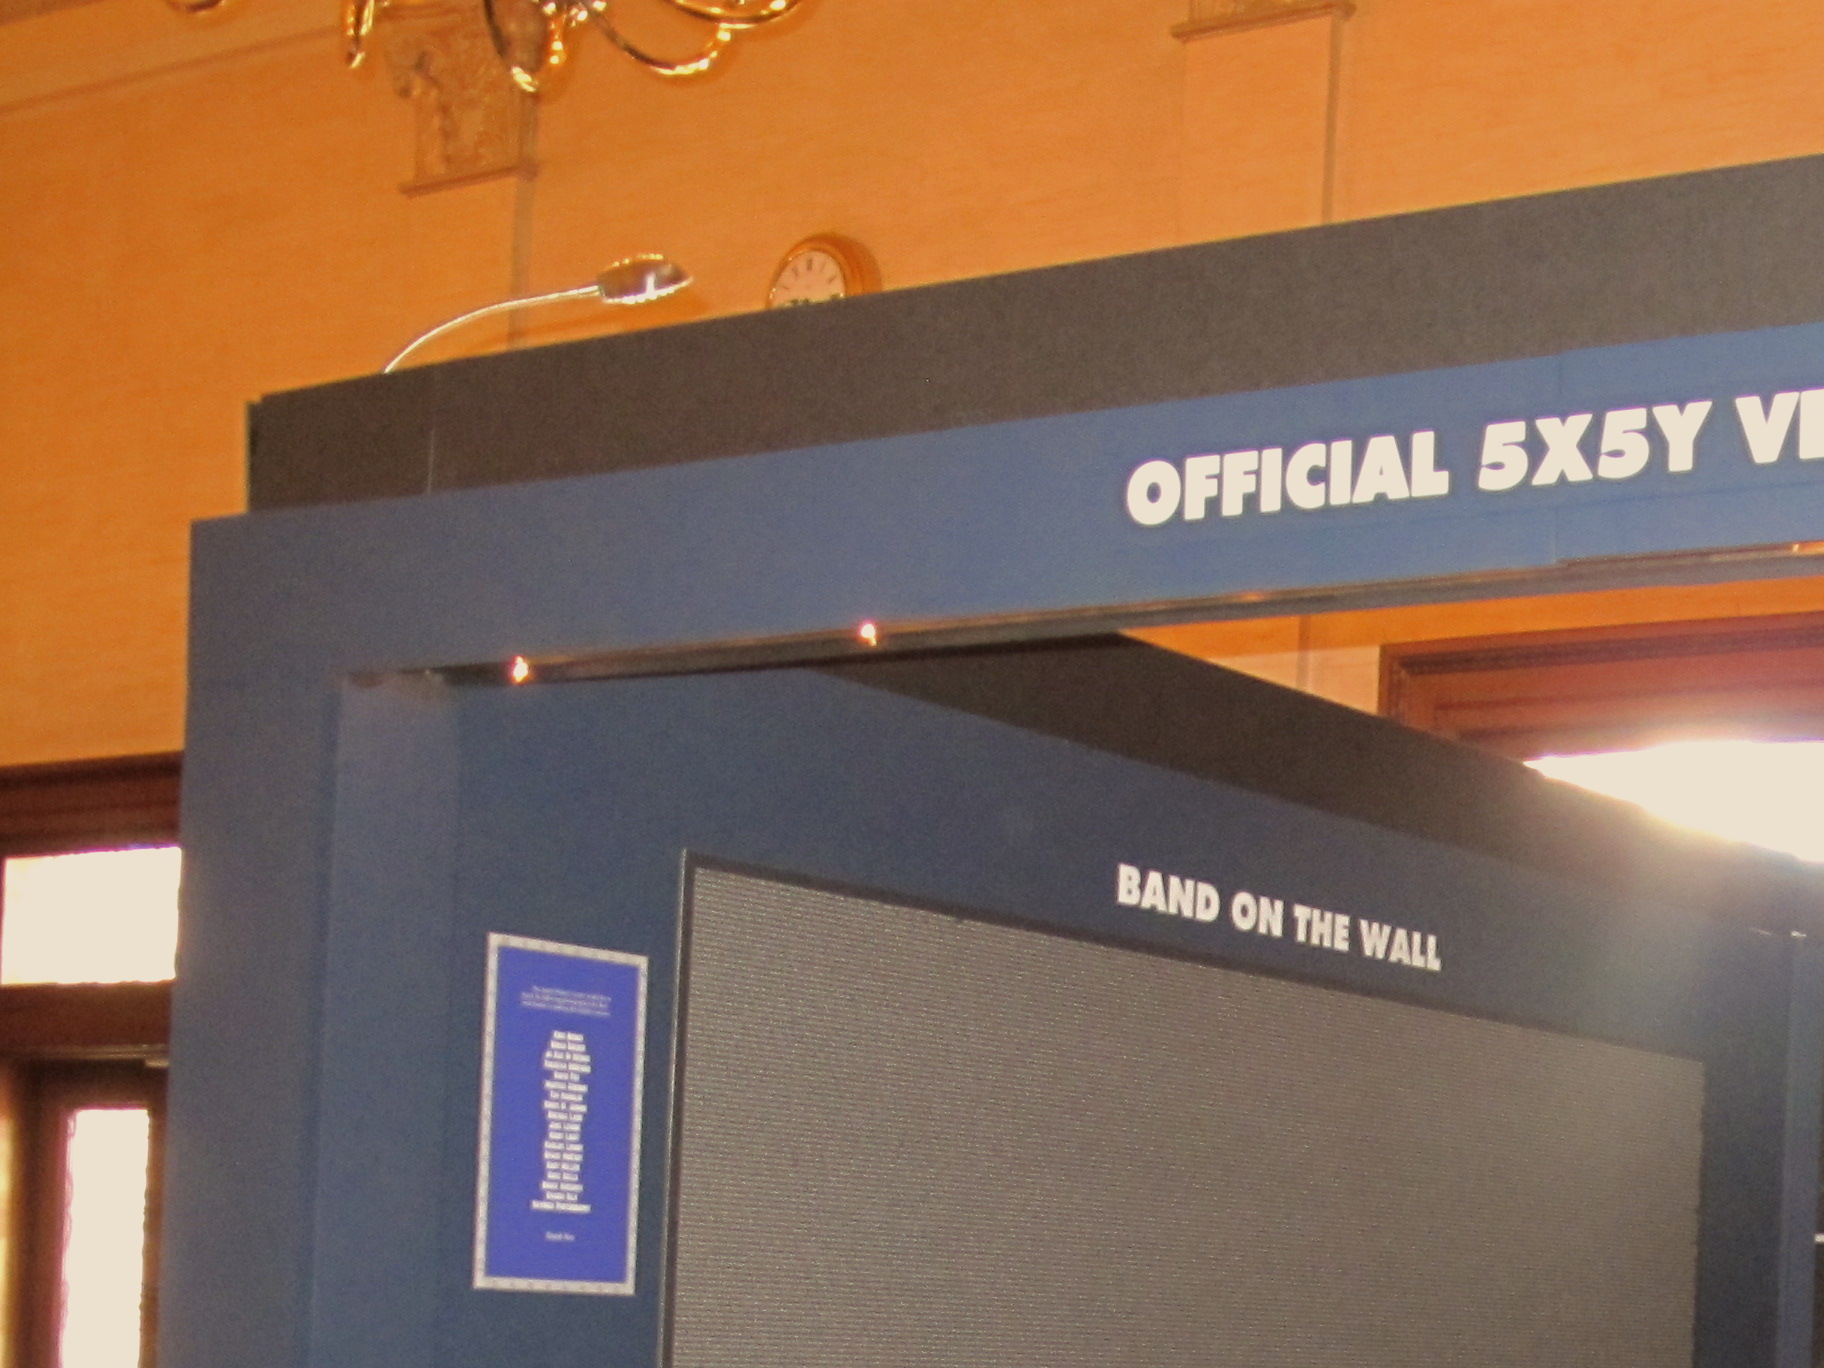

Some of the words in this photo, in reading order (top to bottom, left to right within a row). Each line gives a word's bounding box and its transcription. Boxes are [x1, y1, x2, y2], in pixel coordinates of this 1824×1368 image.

[1125, 428, 1449, 527] OFFICIAL
[1477, 400, 1711, 493] 5X5Y
[1116, 862, 1221, 923] BAND
[1230, 890, 1285, 938] ON
[1293, 903, 1351, 953] THE
[1358, 918, 1443, 972] WALL
